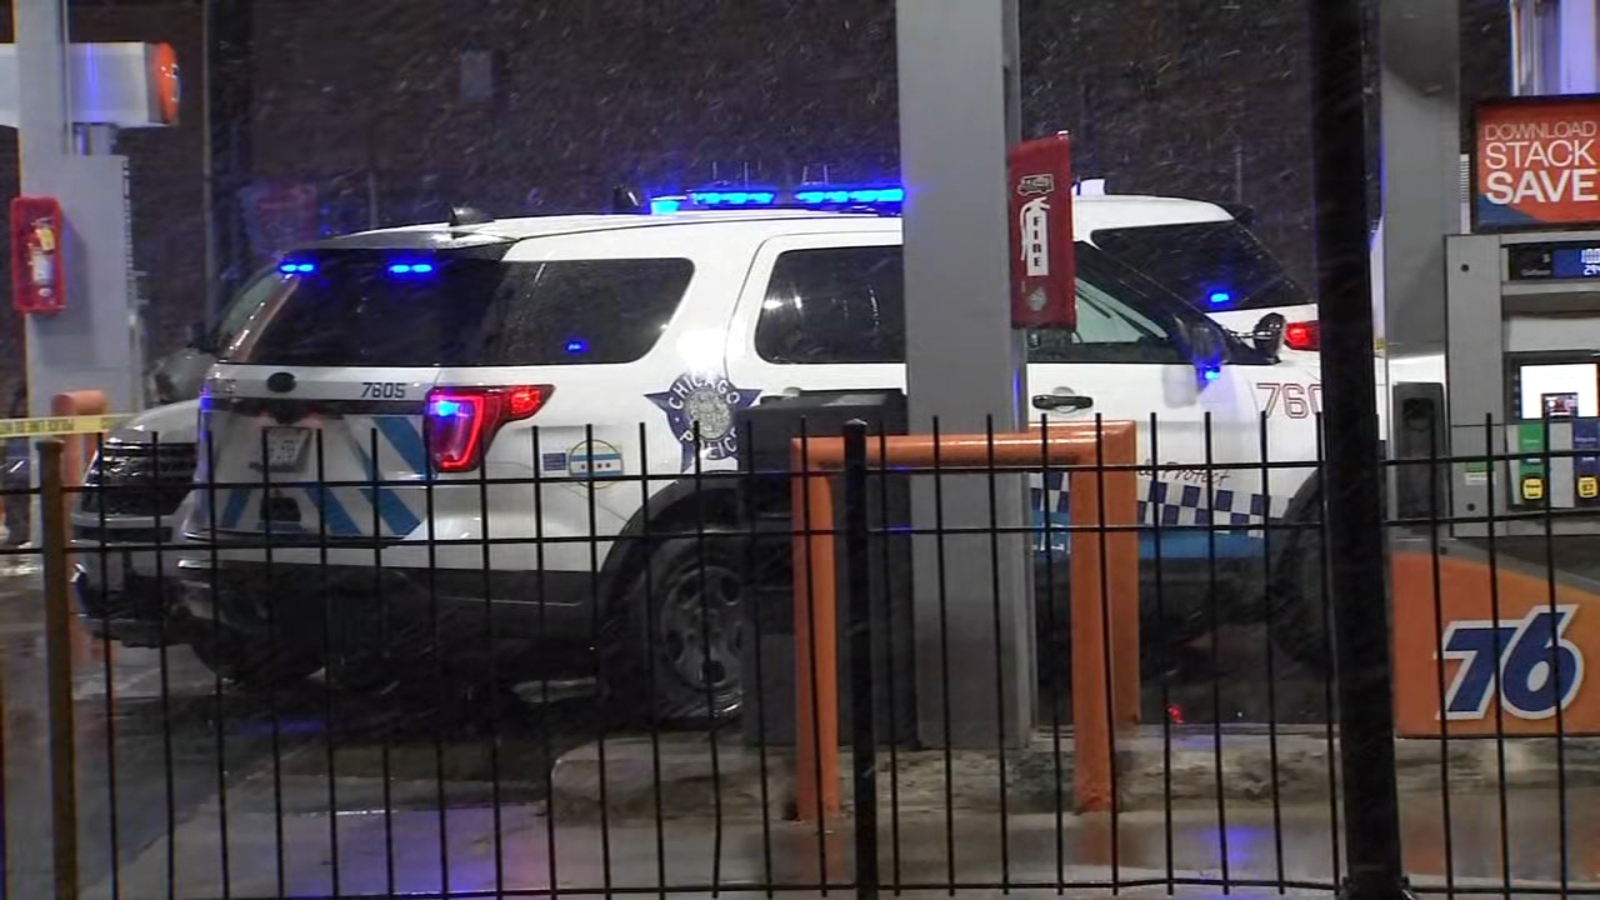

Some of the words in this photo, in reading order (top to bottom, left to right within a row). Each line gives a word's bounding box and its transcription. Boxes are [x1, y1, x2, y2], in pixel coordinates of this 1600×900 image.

[1485, 121, 1597, 141] DOWNLOAD
[1485, 139, 1596, 169] STACK
[1486, 168, 1599, 205] SAVE
[1032, 215, 1043, 267] FIRE
[361, 381, 407, 399] 7605
[668, 374, 741, 410] CHICAGO
[1433, 604, 1585, 720] 76
